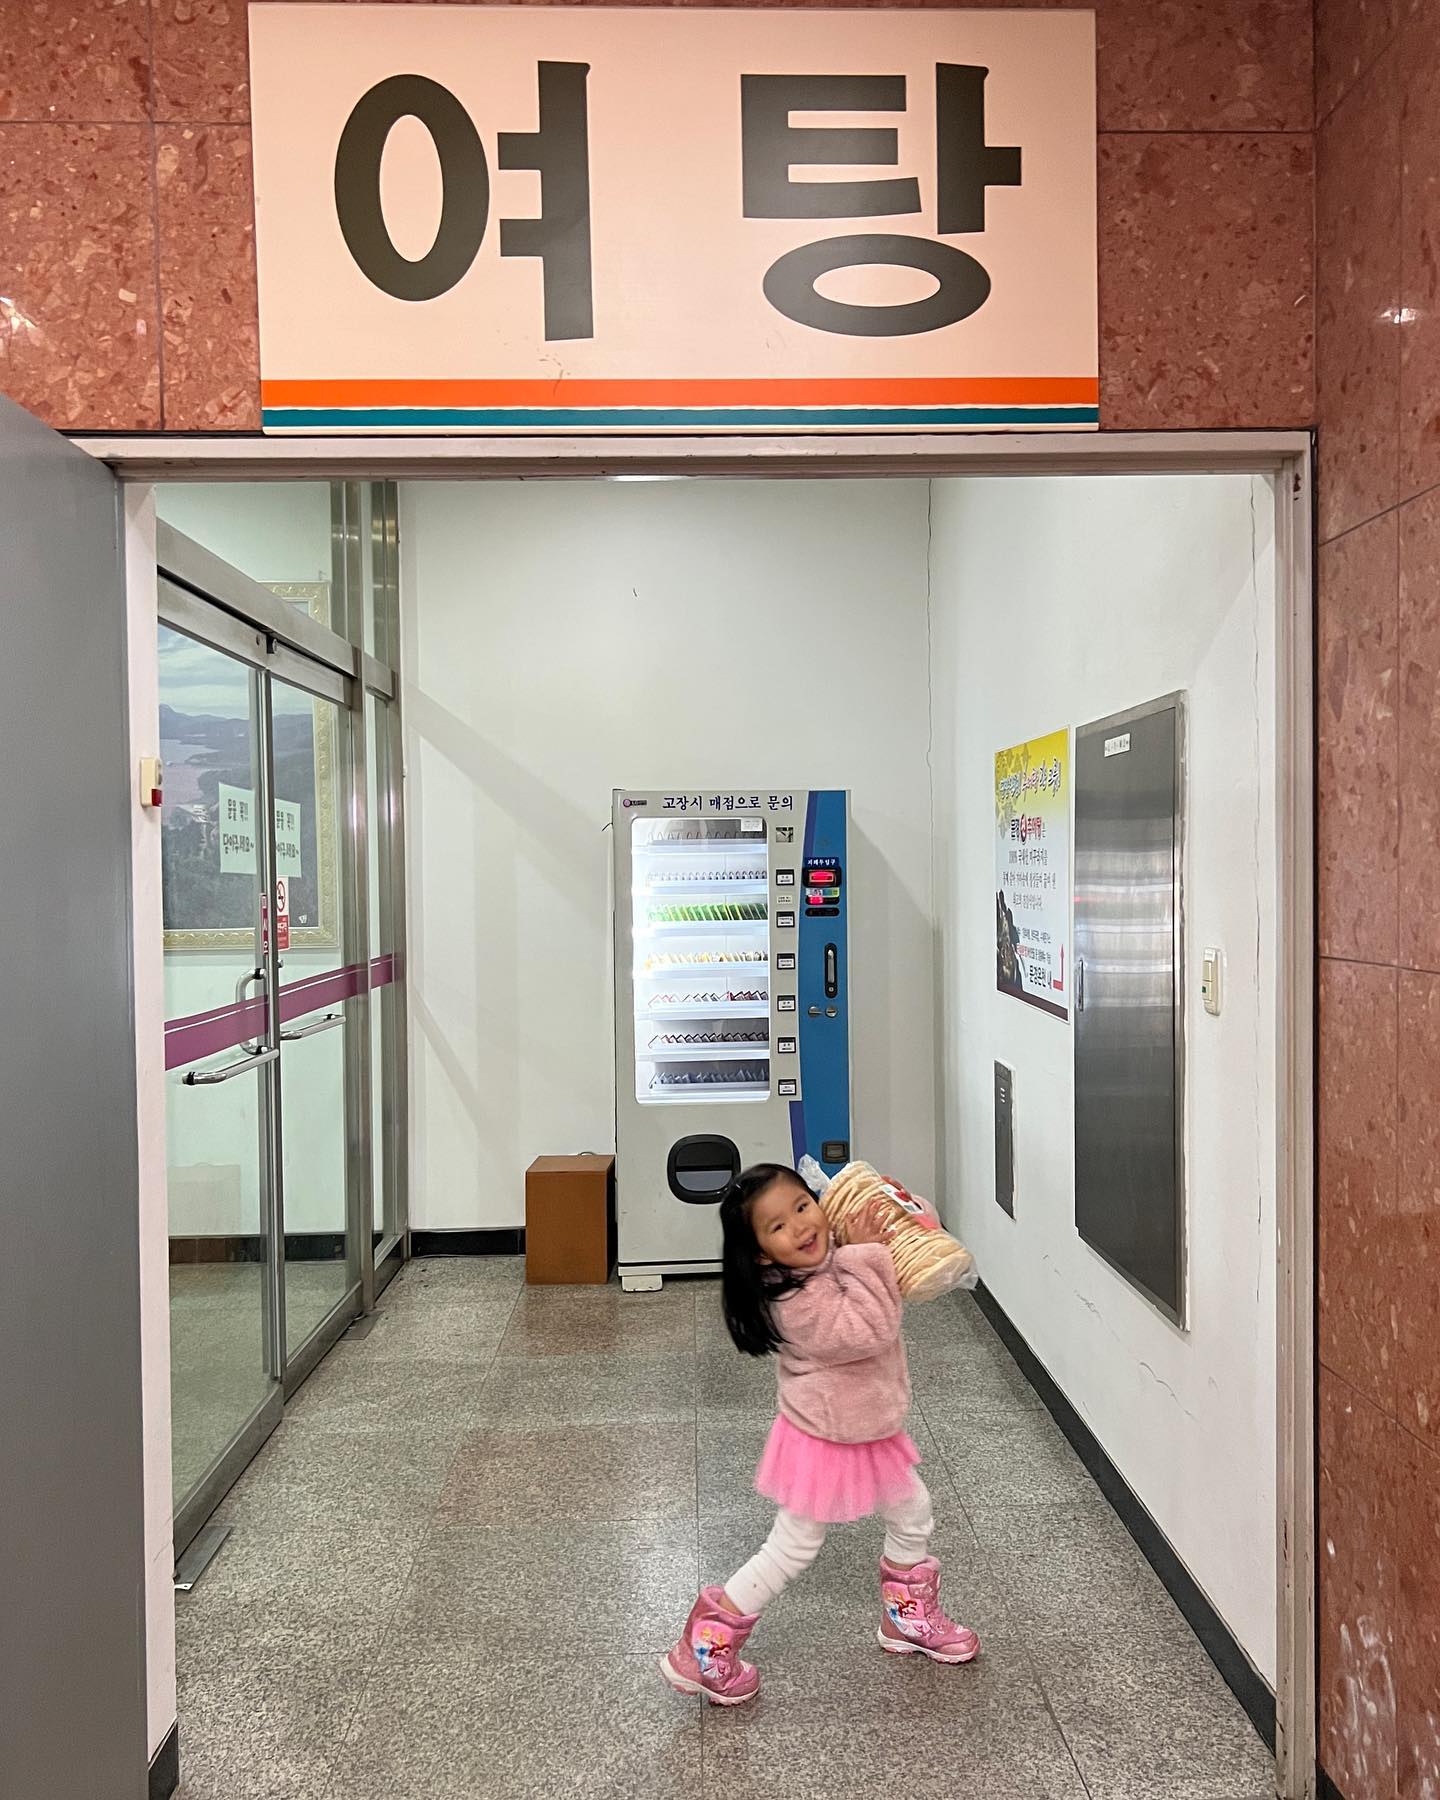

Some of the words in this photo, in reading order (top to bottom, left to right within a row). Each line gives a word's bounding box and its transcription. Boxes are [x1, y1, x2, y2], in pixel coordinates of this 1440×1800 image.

[662, 795, 703, 811] 고장시
[709, 795, 761, 810] 매점으로
[767, 795, 793, 811] 문의
